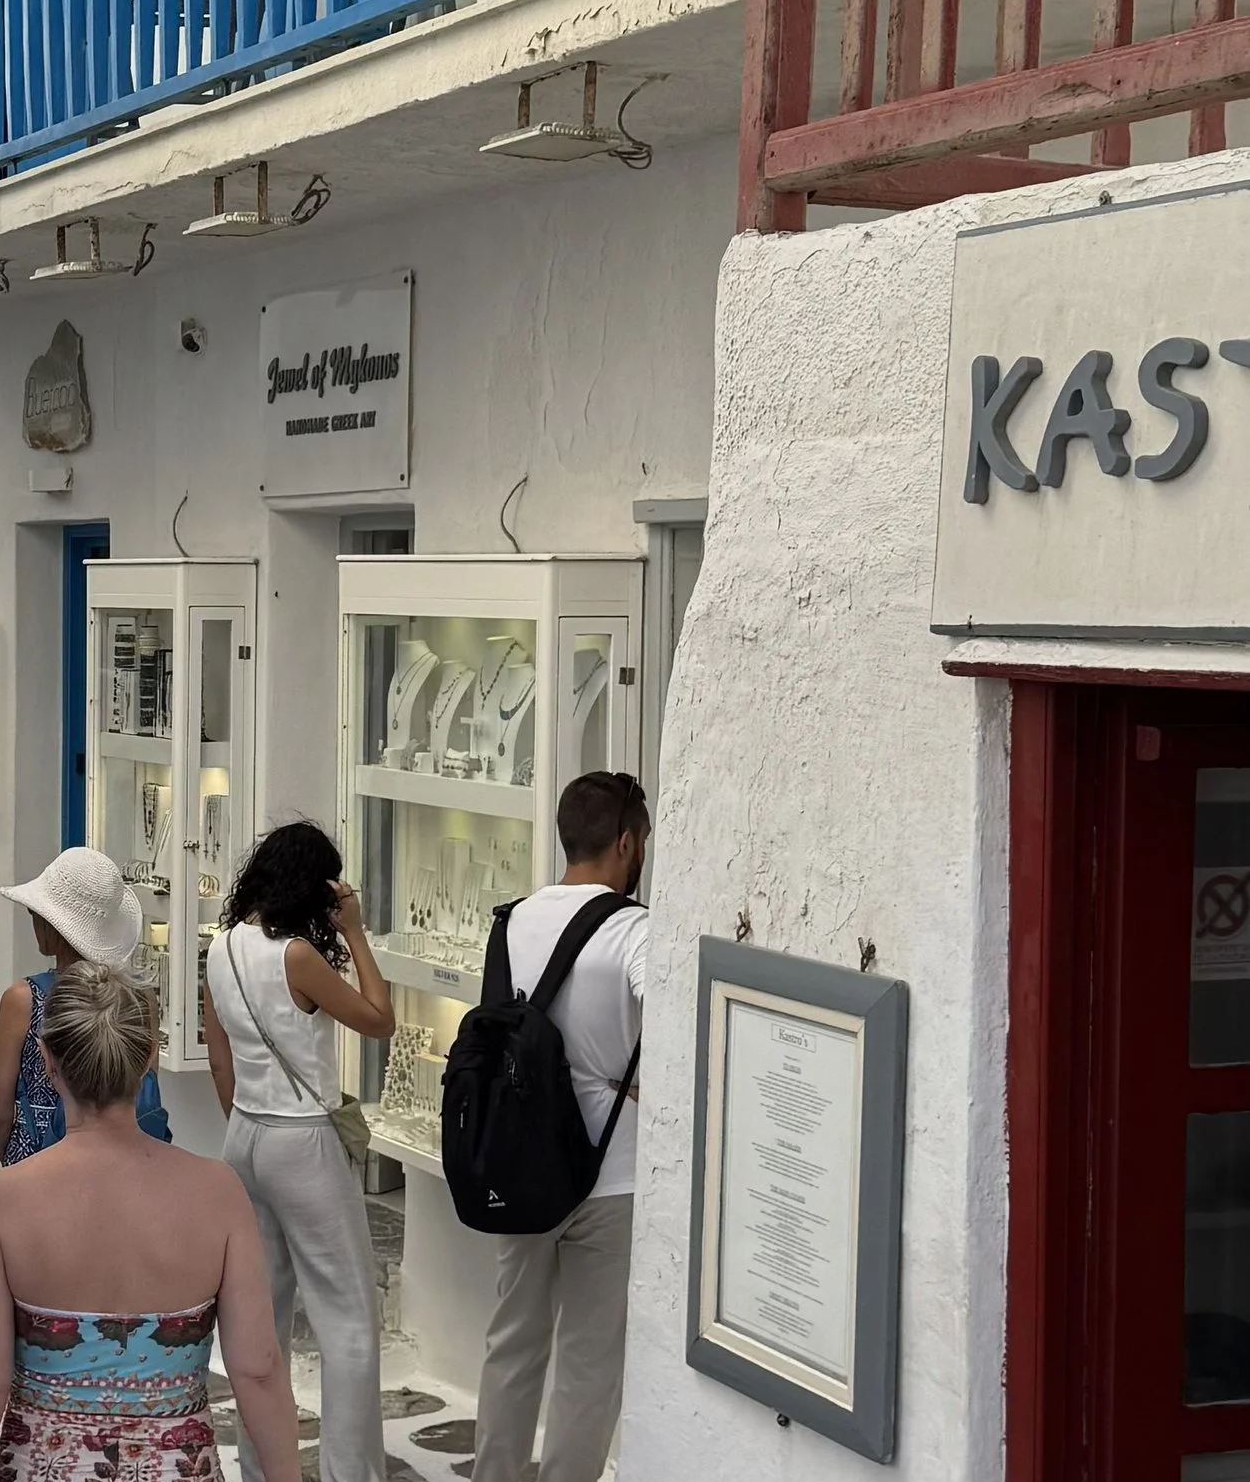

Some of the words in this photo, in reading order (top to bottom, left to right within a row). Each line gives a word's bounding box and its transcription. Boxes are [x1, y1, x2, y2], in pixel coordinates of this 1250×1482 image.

[267, 352, 310, 404] Jewel
[311, 349, 329, 398] of
[329, 342, 400, 394] Mykonos
[286, 416, 330, 436] HANDMADE
[331, 412, 359, 432] GREEK
[360, 410, 376, 429] ART
